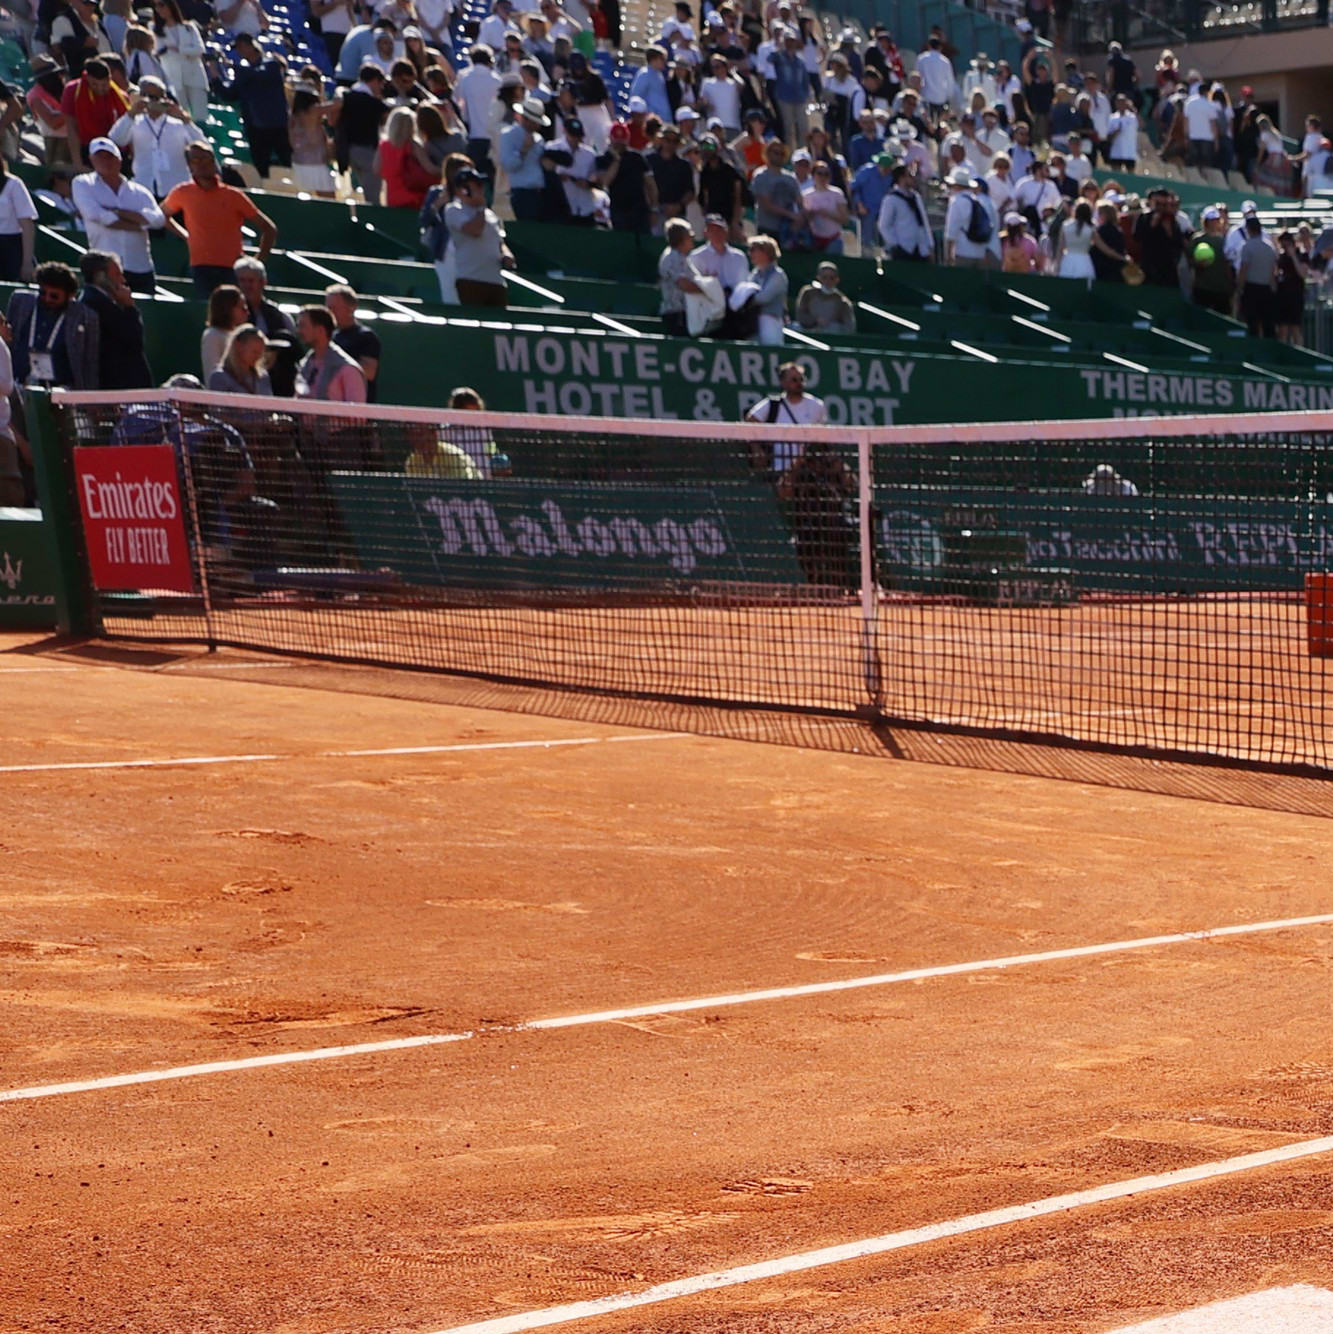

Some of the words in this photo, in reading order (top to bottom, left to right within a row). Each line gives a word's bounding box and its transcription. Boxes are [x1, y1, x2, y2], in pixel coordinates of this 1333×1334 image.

[838, 357, 917, 394] BAY
[1080, 369, 1233, 407] THERMES
[523, 379, 679, 421] HOTEL
[695, 391, 725, 422] &
[81, 472, 177, 520] Emirates
[105, 526, 125, 564] FLY
[127, 527, 171, 565] BETTER
[423, 495, 729, 575] Malongo
